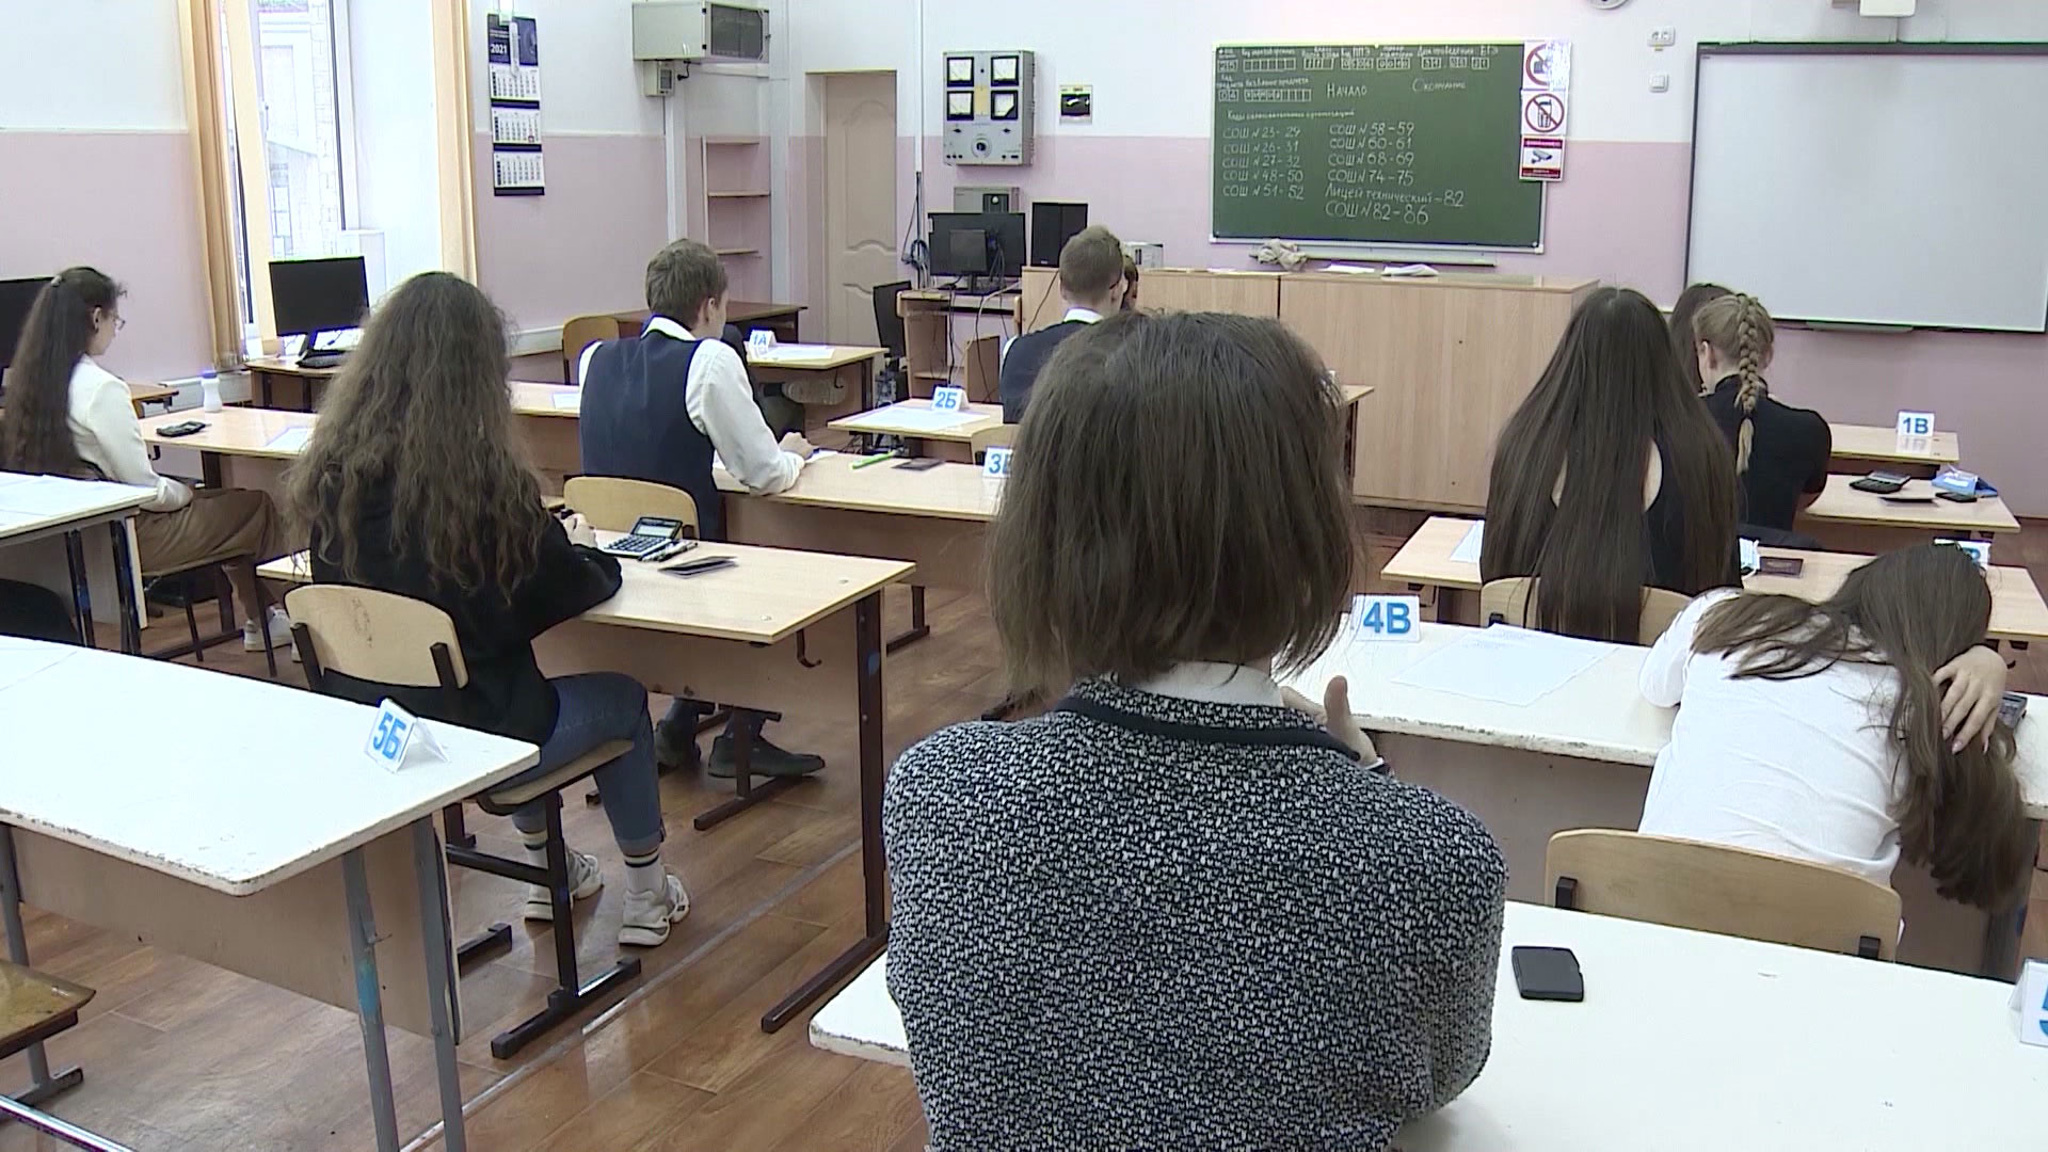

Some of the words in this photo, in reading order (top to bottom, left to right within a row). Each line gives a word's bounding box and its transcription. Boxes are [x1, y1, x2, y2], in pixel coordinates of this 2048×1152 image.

[490, 43, 508, 54] 2021
[1223, 127, 1249, 138] СОШ
[1329, 124, 1356, 135] СОШ
[1370, 122, 1385, 136] 58
[1397, 121, 1414, 136] 59
[1223, 142, 1249, 154] СОШ
[1329, 138, 1356, 149] СОШ
[1368, 136, 1387, 150] 60
[1396, 136, 1412, 150] 61
[1222, 157, 1249, 168] СОШ
[1328, 153, 1355, 166] СОШ
[1367, 151, 1387, 165] 68
[1396, 151, 1414, 167] 69
[1223, 170, 1249, 181] СОШ
[1287, 169, 1303, 182] 50
[1328, 169, 1357, 183] СОШ
[1368, 169, 1384, 184] 74
[1397, 169, 1414, 187] 75
[1223, 185, 1249, 196] СОШ
[1288, 184, 1304, 200] 52
[1443, 189, 1464, 207] 82
[1326, 200, 1359, 218] СОШ
[1372, 202, 1391, 220] 82
[1404, 203, 1429, 225] 86
[935, 391, 957, 409] 2Б
[1903, 417, 1929, 434] 1В
[1363, 602, 1411, 634] 4В
[373, 711, 407, 760] 5Б
